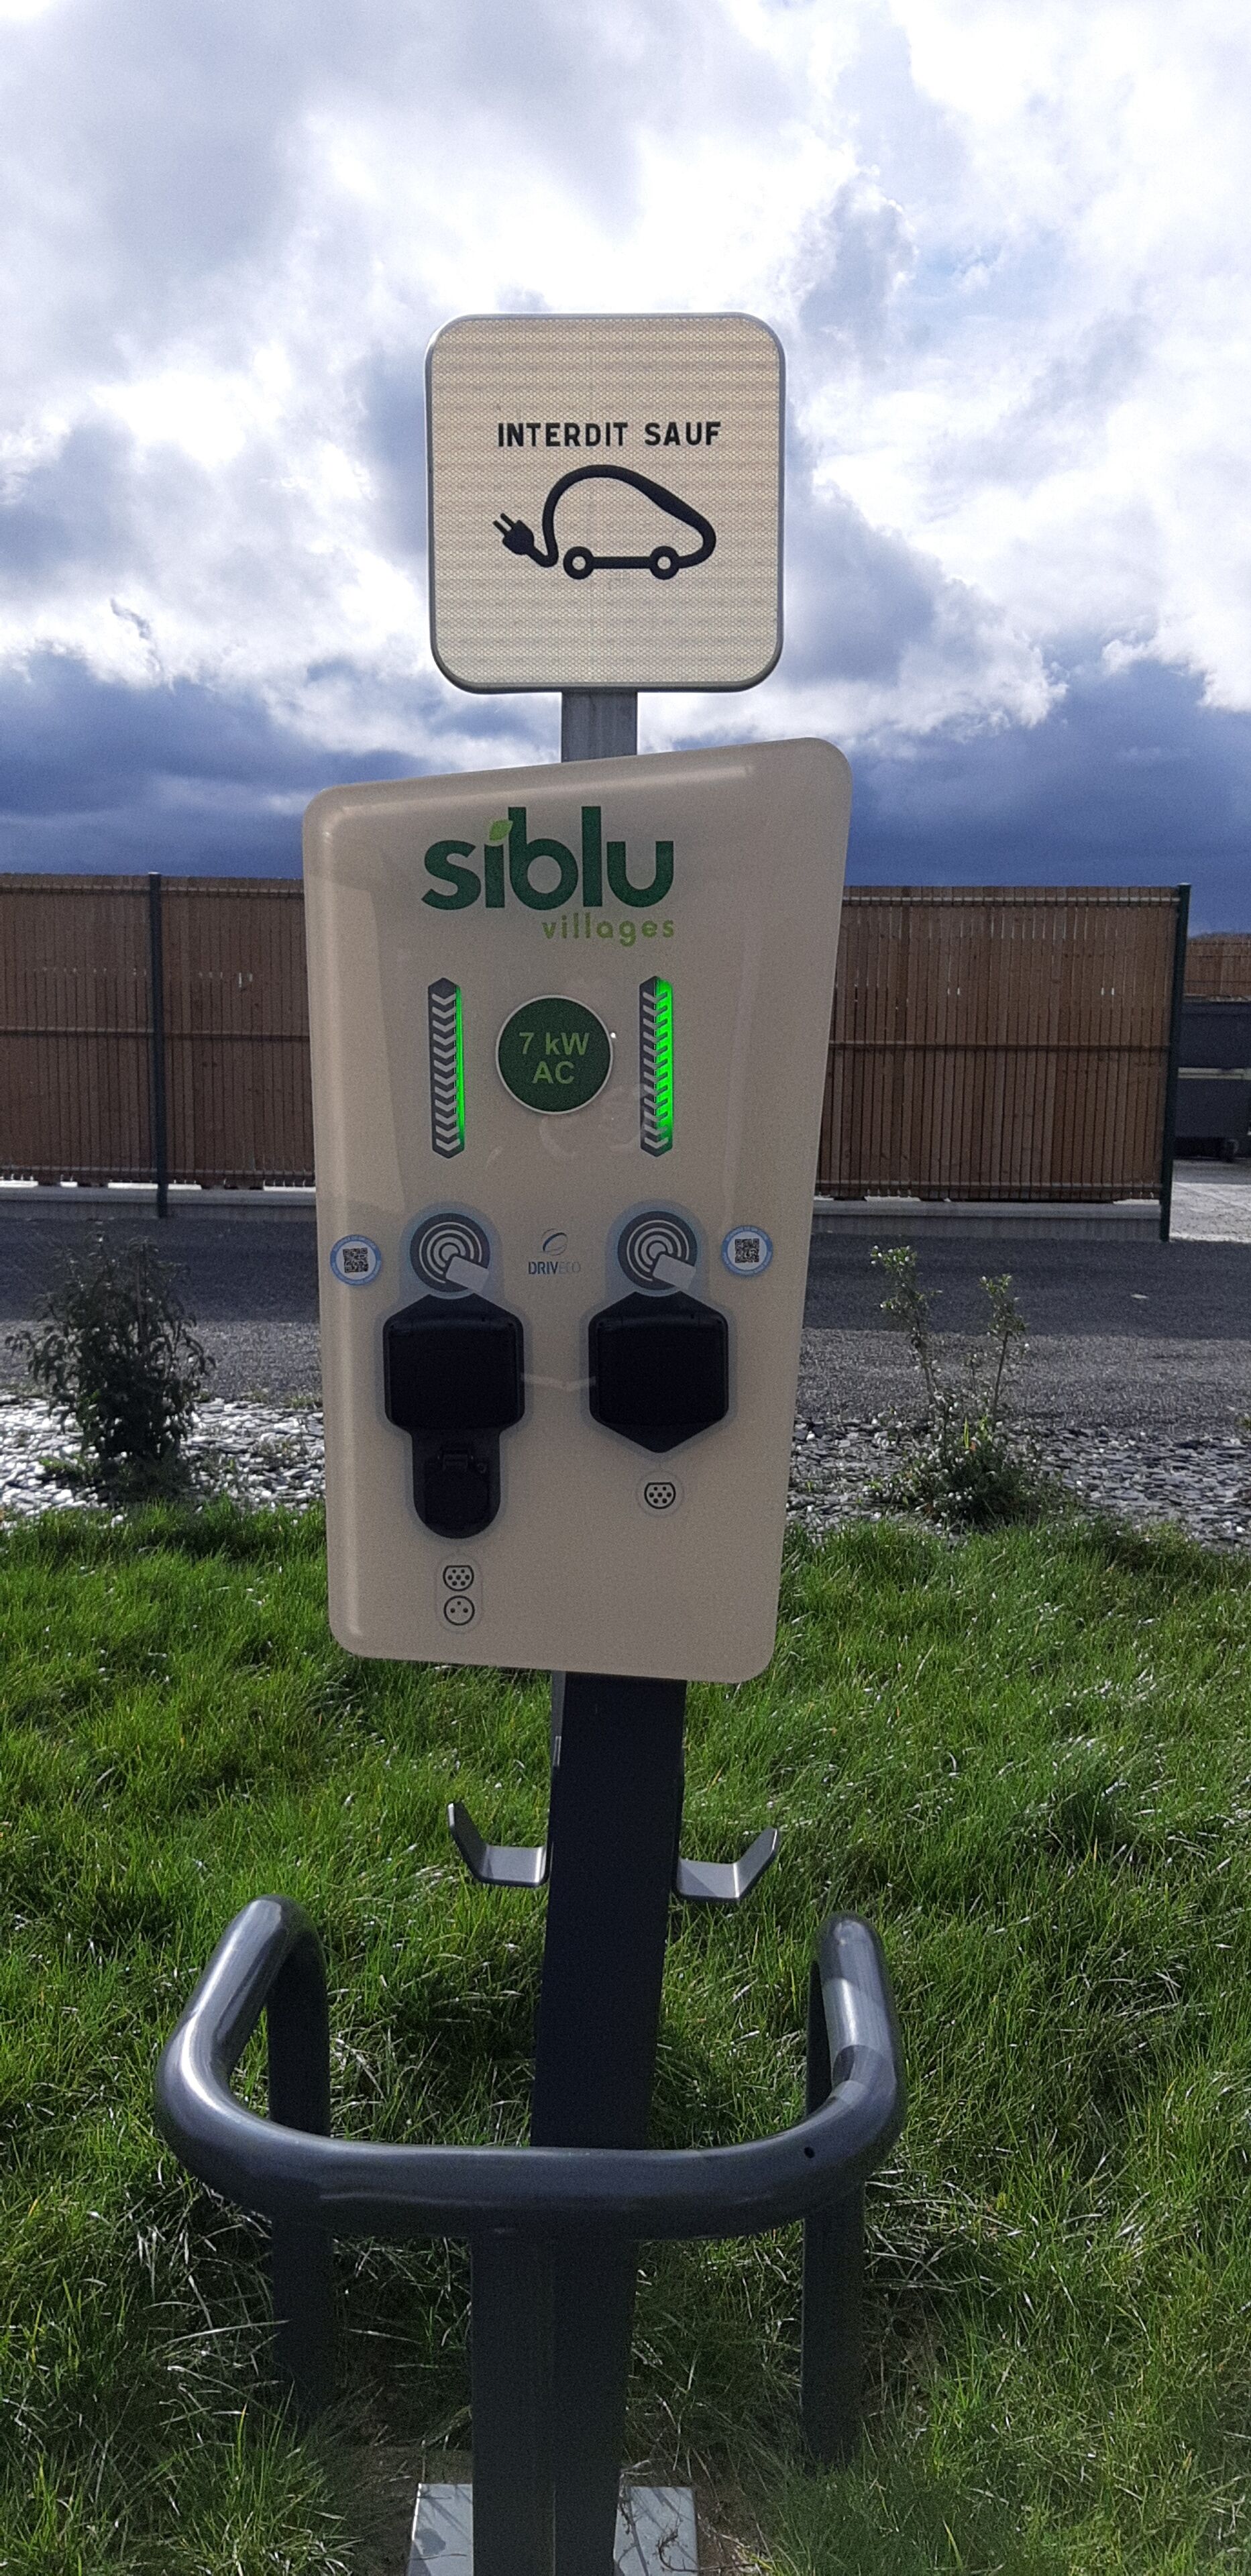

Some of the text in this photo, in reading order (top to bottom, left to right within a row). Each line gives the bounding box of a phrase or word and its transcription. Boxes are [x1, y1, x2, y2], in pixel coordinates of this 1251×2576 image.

[498, 421, 721, 447] INTERDIT SAUF
[421, 806, 675, 911] siblu
[541, 912, 675, 947] villages
[519, 1032, 590, 1055] 7 kW
[532, 1061, 575, 1084] AC
